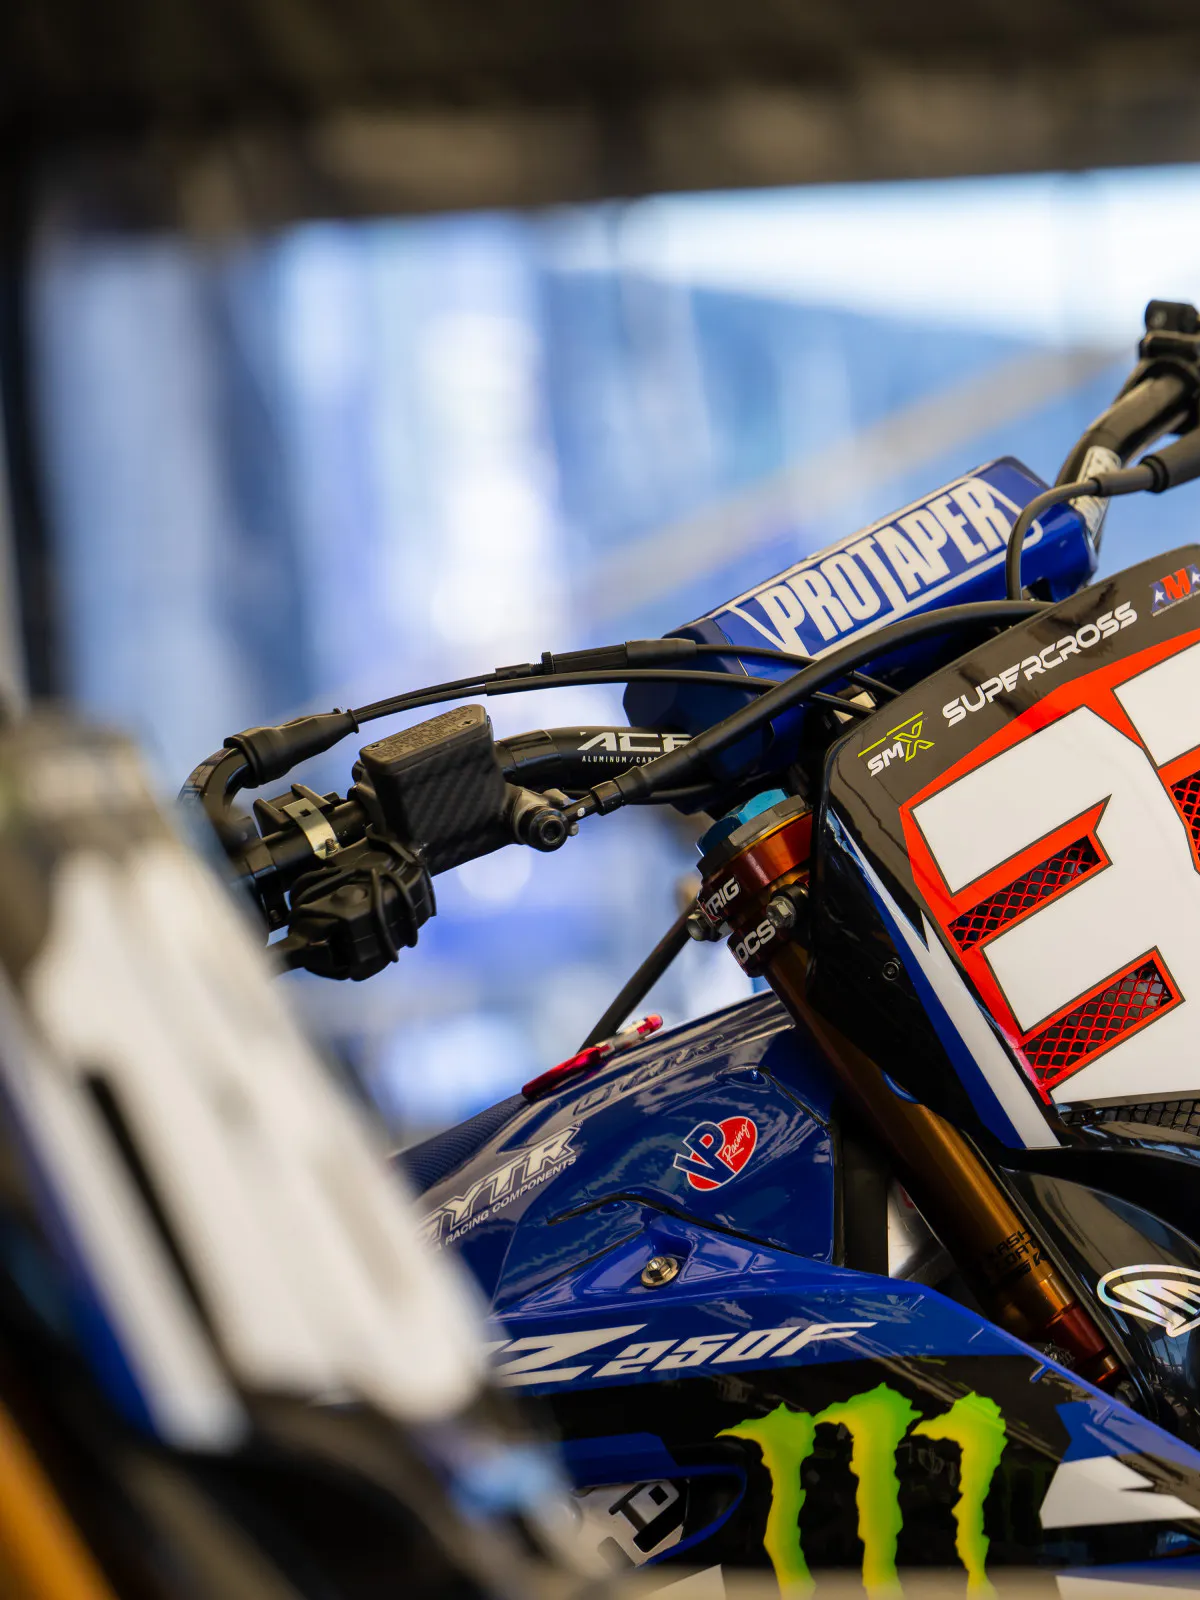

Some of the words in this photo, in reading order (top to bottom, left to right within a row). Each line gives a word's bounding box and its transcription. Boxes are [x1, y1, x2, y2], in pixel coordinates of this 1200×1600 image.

[755, 478, 1024, 660] PROTAPER
[942, 600, 1138, 728] SUPERCROSS
[867, 719, 935, 777] SMX
[673, 1121, 738, 1186] VP
[722, 1119, 751, 1165] Racing
[445, 1210, 490, 1246] RACING
[492, 1155, 577, 1214] COMPONENTS
